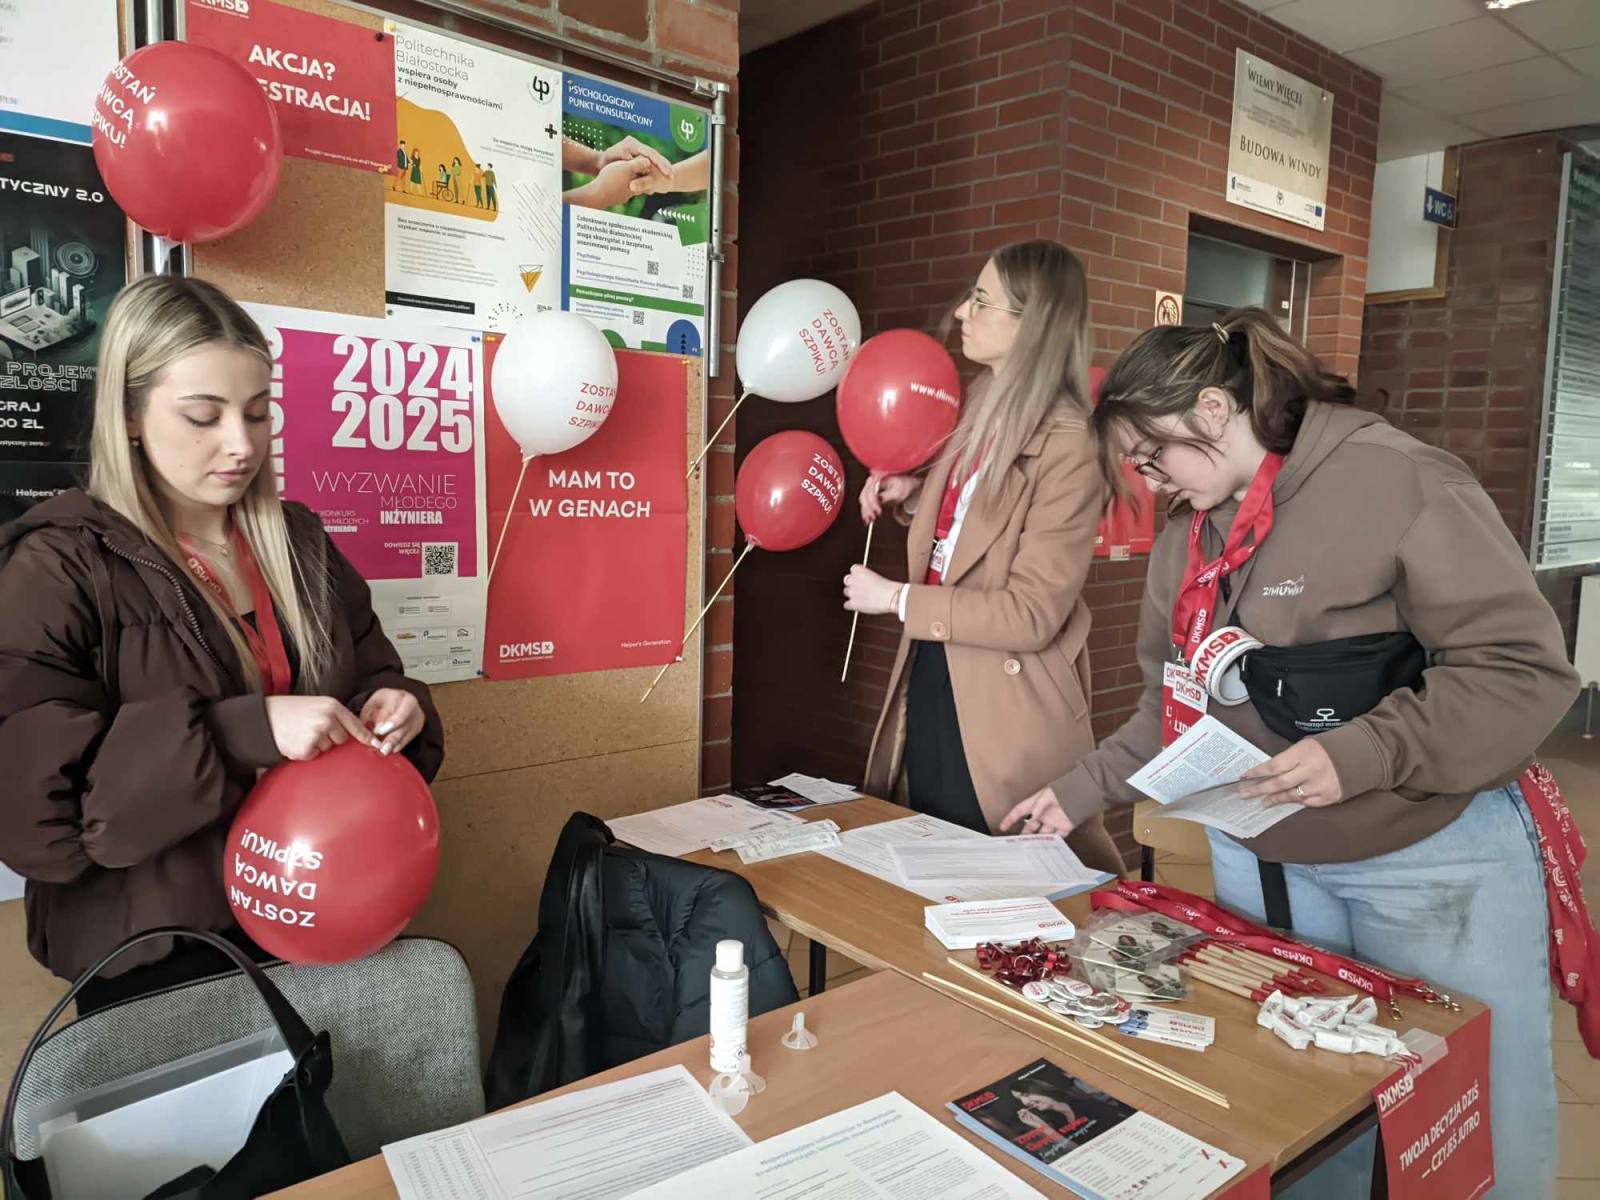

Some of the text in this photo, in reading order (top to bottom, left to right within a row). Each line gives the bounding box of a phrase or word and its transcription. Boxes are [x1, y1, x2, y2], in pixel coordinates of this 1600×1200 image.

[248, 44, 336, 81] AKCJA?
[396, 34, 475, 69] Politechnika
[396, 49, 469, 81] Białostocka
[397, 65, 458, 89] wspiera osoby
[1247, 68, 1275, 92] WIEMY
[256, 77, 371, 122] STRACJA!
[404, 78, 503, 111] niepełnosprawnościami
[568, 85, 636, 110] PSYCHOLOGICZNY
[568, 96, 654, 128] PUNKT KONSULTACYJNY
[1239, 134, 1322, 180] BUDOWA WINDY
[75, 188, 104, 204] 2.0
[1434, 200, 1447, 217] WC
[332, 335, 473, 400] 2024
[331, 391, 473, 454] 2025
[311, 470, 457, 495] WYZWANIE
[548, 470, 635, 490] MAM TO
[380, 495, 457, 510] MŁODEGO
[380, 508, 443, 526] INŻYNIERA
[529, 499, 651, 519] W GENACH
[500, 643, 540, 657] DKMS
[235, 852, 317, 900] DAWCĄ
[231, 885, 316, 928] ZOSTAŃ
[1378, 1078, 1407, 1112] DKMS
[1399, 1079, 1479, 1171] TWOJA DECYZJA DZIŚ
[1457, 1111, 1480, 1145] JUTRO
